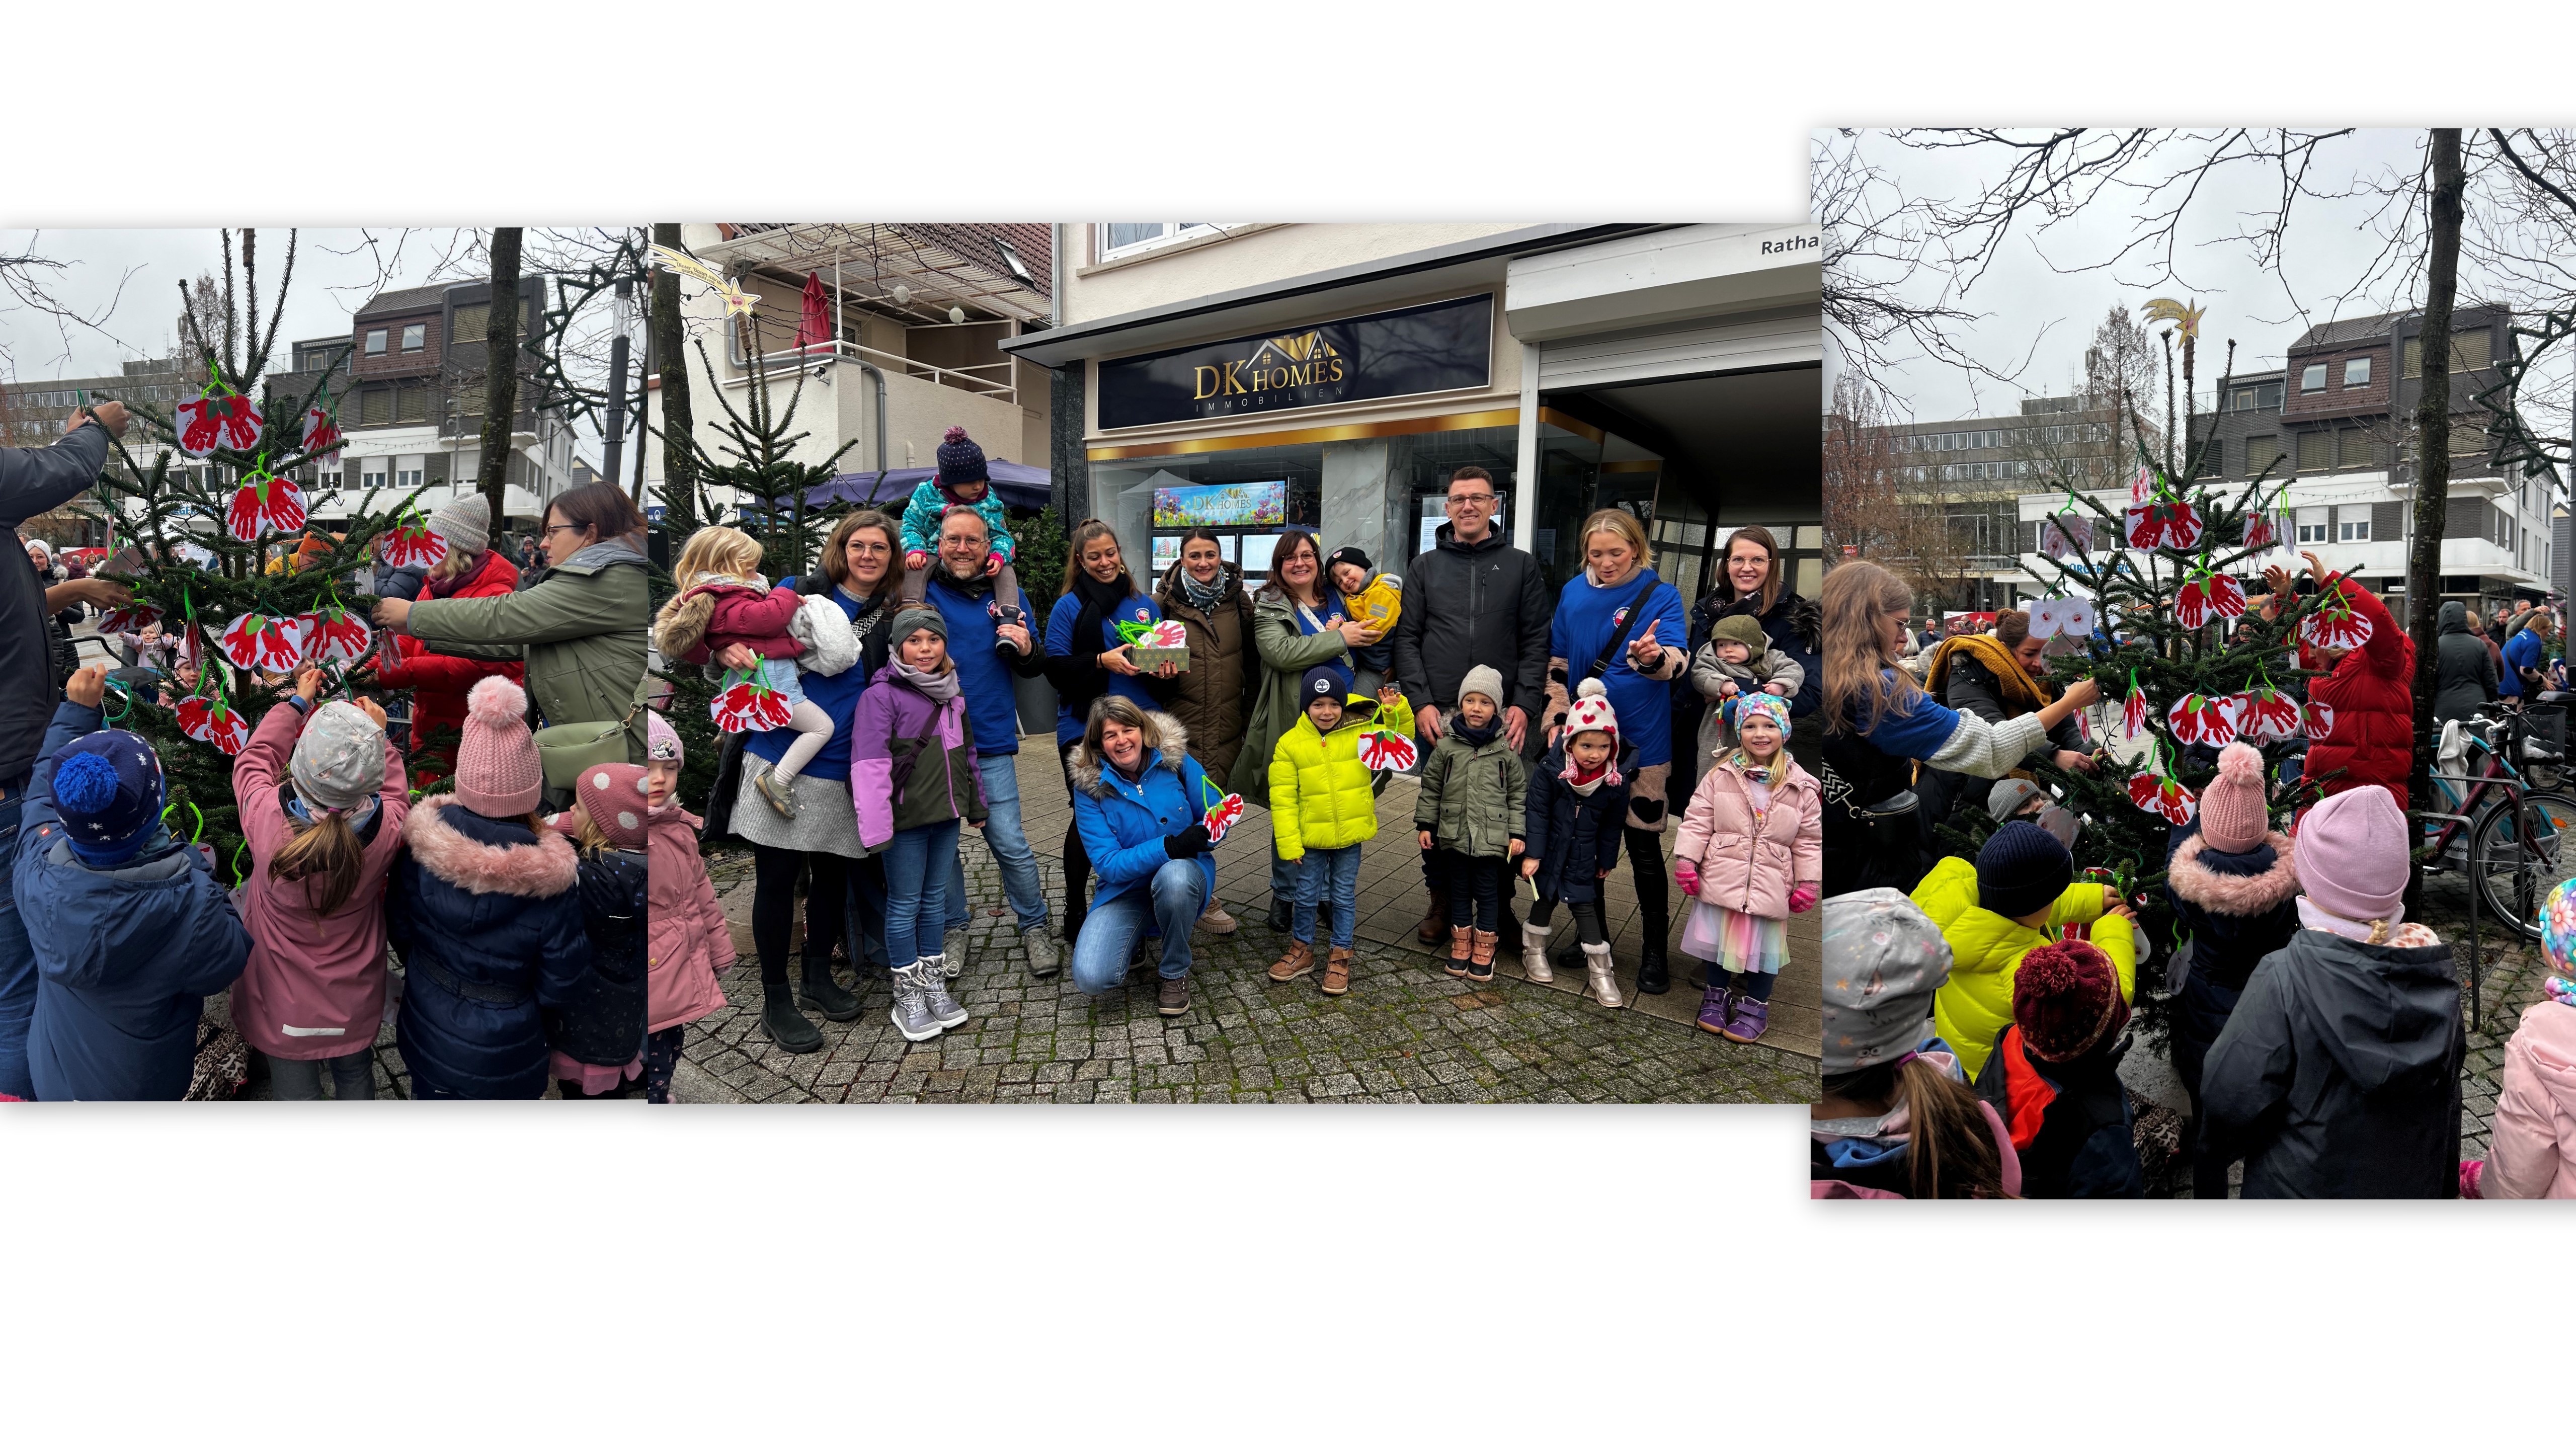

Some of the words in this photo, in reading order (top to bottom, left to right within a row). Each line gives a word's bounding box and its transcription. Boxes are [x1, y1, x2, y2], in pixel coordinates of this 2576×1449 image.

[1761, 235, 1822, 255] Ratha
[676, 262, 692, 270] Dieser
[693, 267, 707, 277] Baum
[708, 275, 723, 285] wurde
[1194, 359, 1247, 400] DK
[1252, 358, 1343, 392] HOMES
[1196, 386, 1342, 412] IMMOBILIEN
[228, 493, 236, 513] SOPHIA
[290, 495, 304, 509] SOPHIA
[1193, 496, 1215, 510] DK
[1217, 499, 1251, 510] HOMES
[2230, 587, 2244, 599] SOPHIA
[345, 611, 357, 622] TELLA
[2276, 691, 2287, 700] TELLA
[1396, 733, 1407, 741] TELLA
